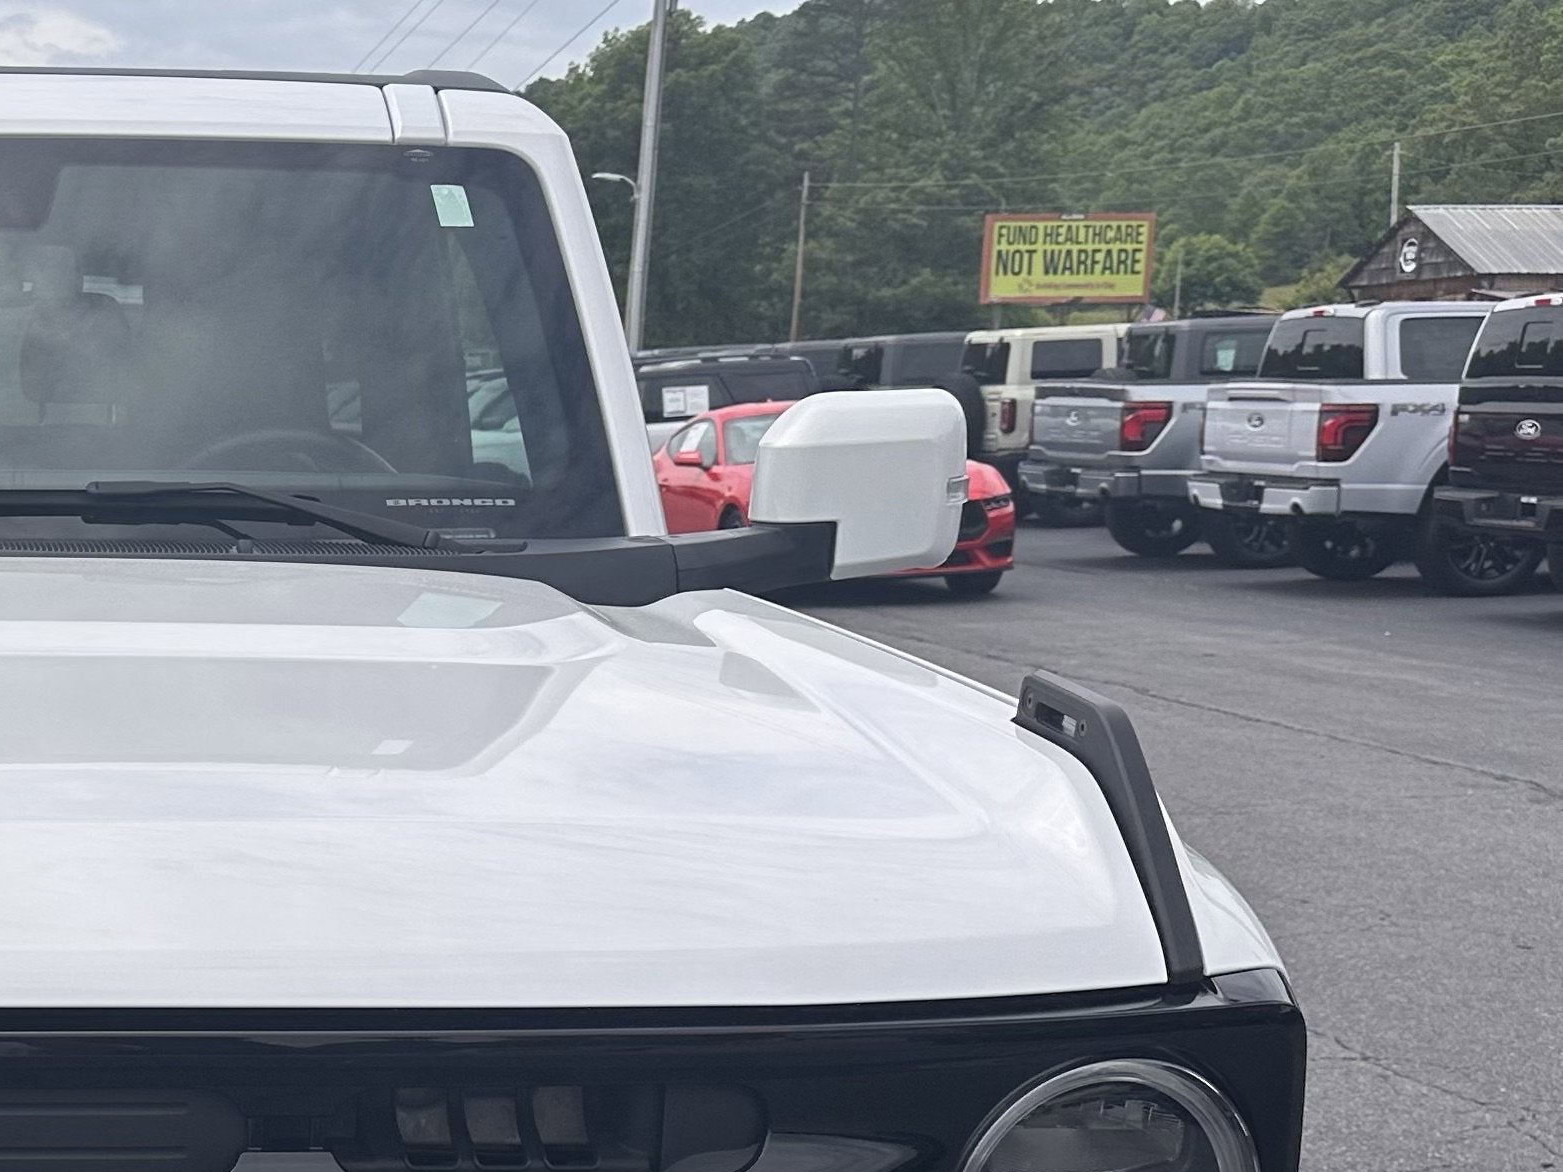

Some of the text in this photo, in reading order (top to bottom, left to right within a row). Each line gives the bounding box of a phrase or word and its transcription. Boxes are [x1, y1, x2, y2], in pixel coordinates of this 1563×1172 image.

[996, 224, 1145, 246] FUND HEALTHCARE
[995, 249, 1142, 276] NOT WARFARE
[385, 498, 516, 507] BRONCO
